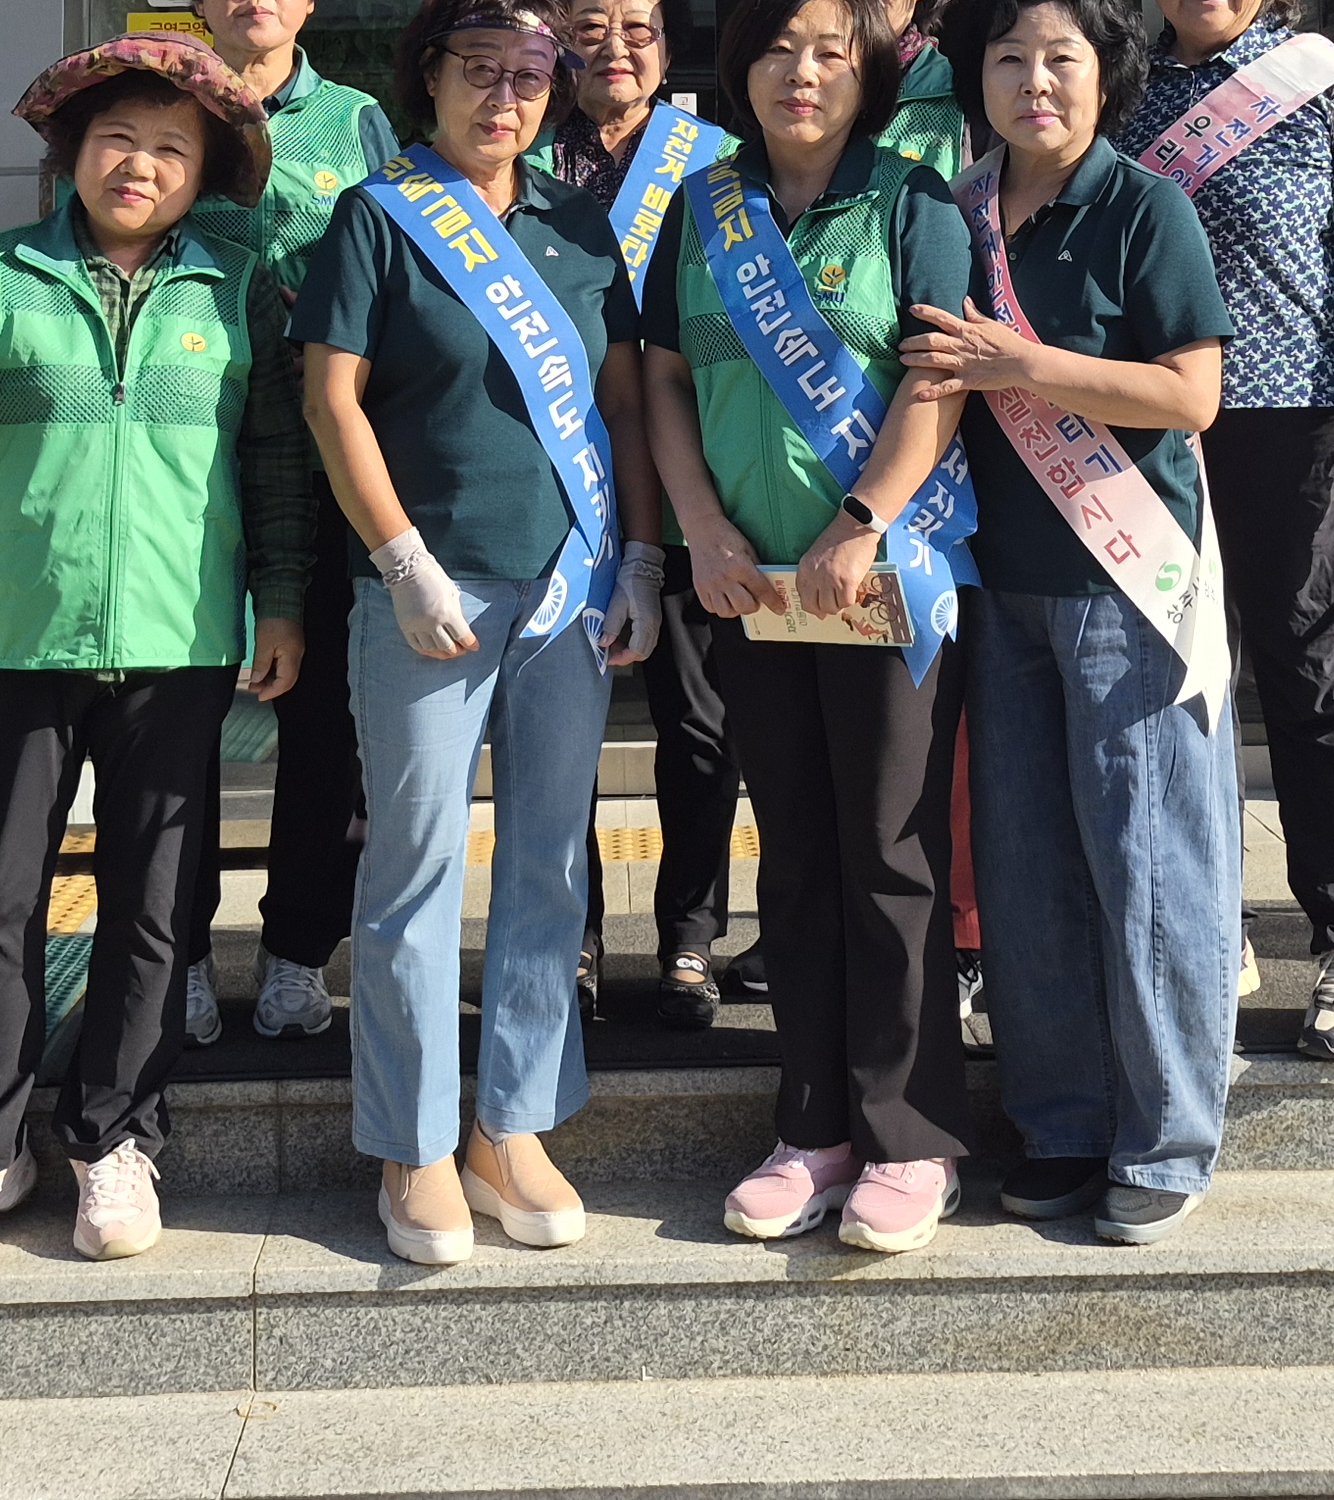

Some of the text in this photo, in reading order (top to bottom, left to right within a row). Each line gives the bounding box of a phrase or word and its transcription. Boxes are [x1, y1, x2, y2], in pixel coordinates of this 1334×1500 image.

[620, 117, 700, 282] 자전거 바로타
[1154, 115, 1212, 171] 우리
[485, 273, 584, 441] 안전속도
[707, 151, 754, 252] 속금지
[736, 253, 847, 412] 안전속도
[998, 386, 1142, 565] 실천합시다
